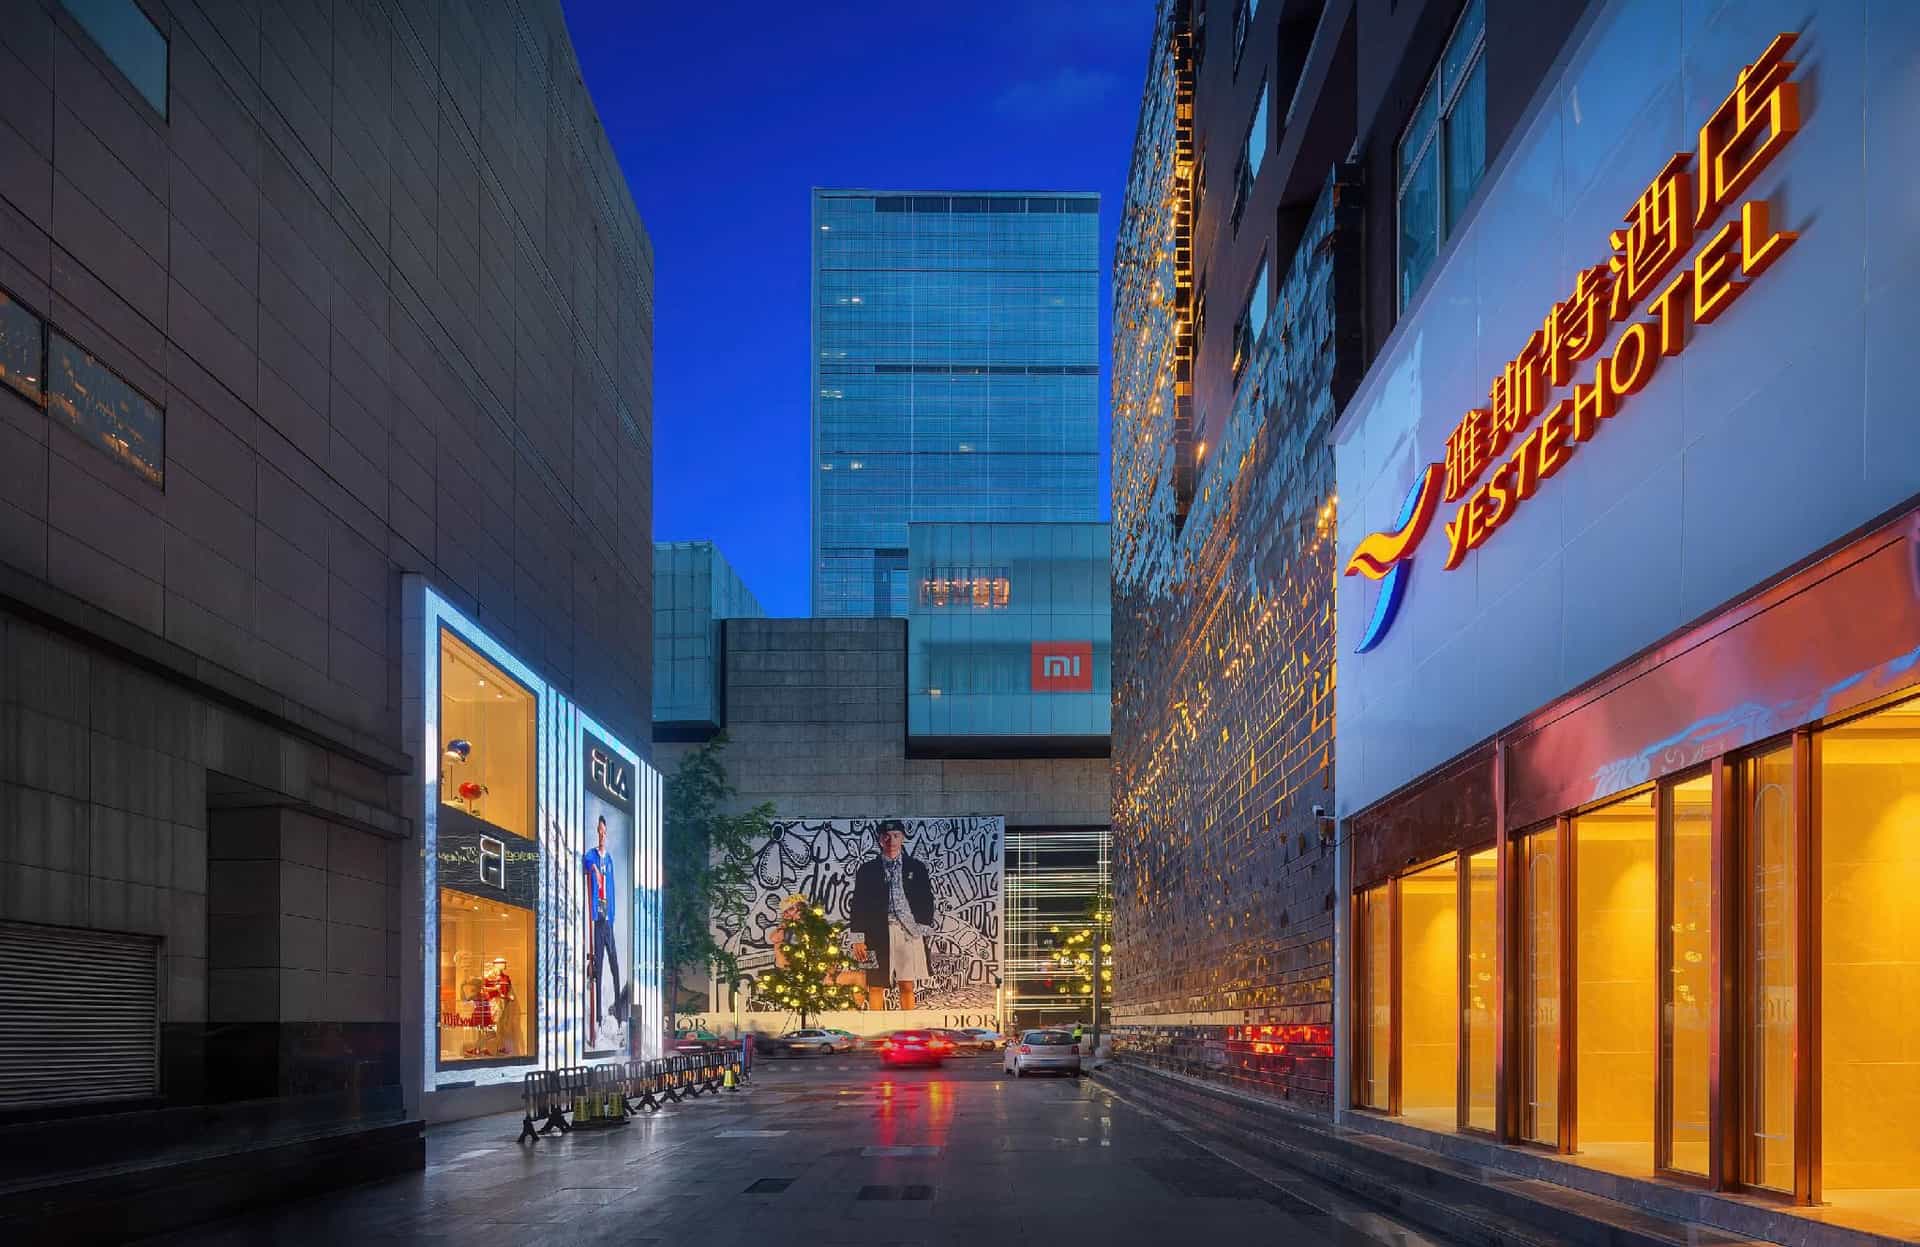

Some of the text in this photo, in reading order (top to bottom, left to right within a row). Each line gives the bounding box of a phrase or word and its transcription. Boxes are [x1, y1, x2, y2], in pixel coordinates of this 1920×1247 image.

[1443, 32, 1798, 503] 雅斯特酒店
[591, 748, 629, 801] FILA
[943, 1014, 997, 1028] DIOR
